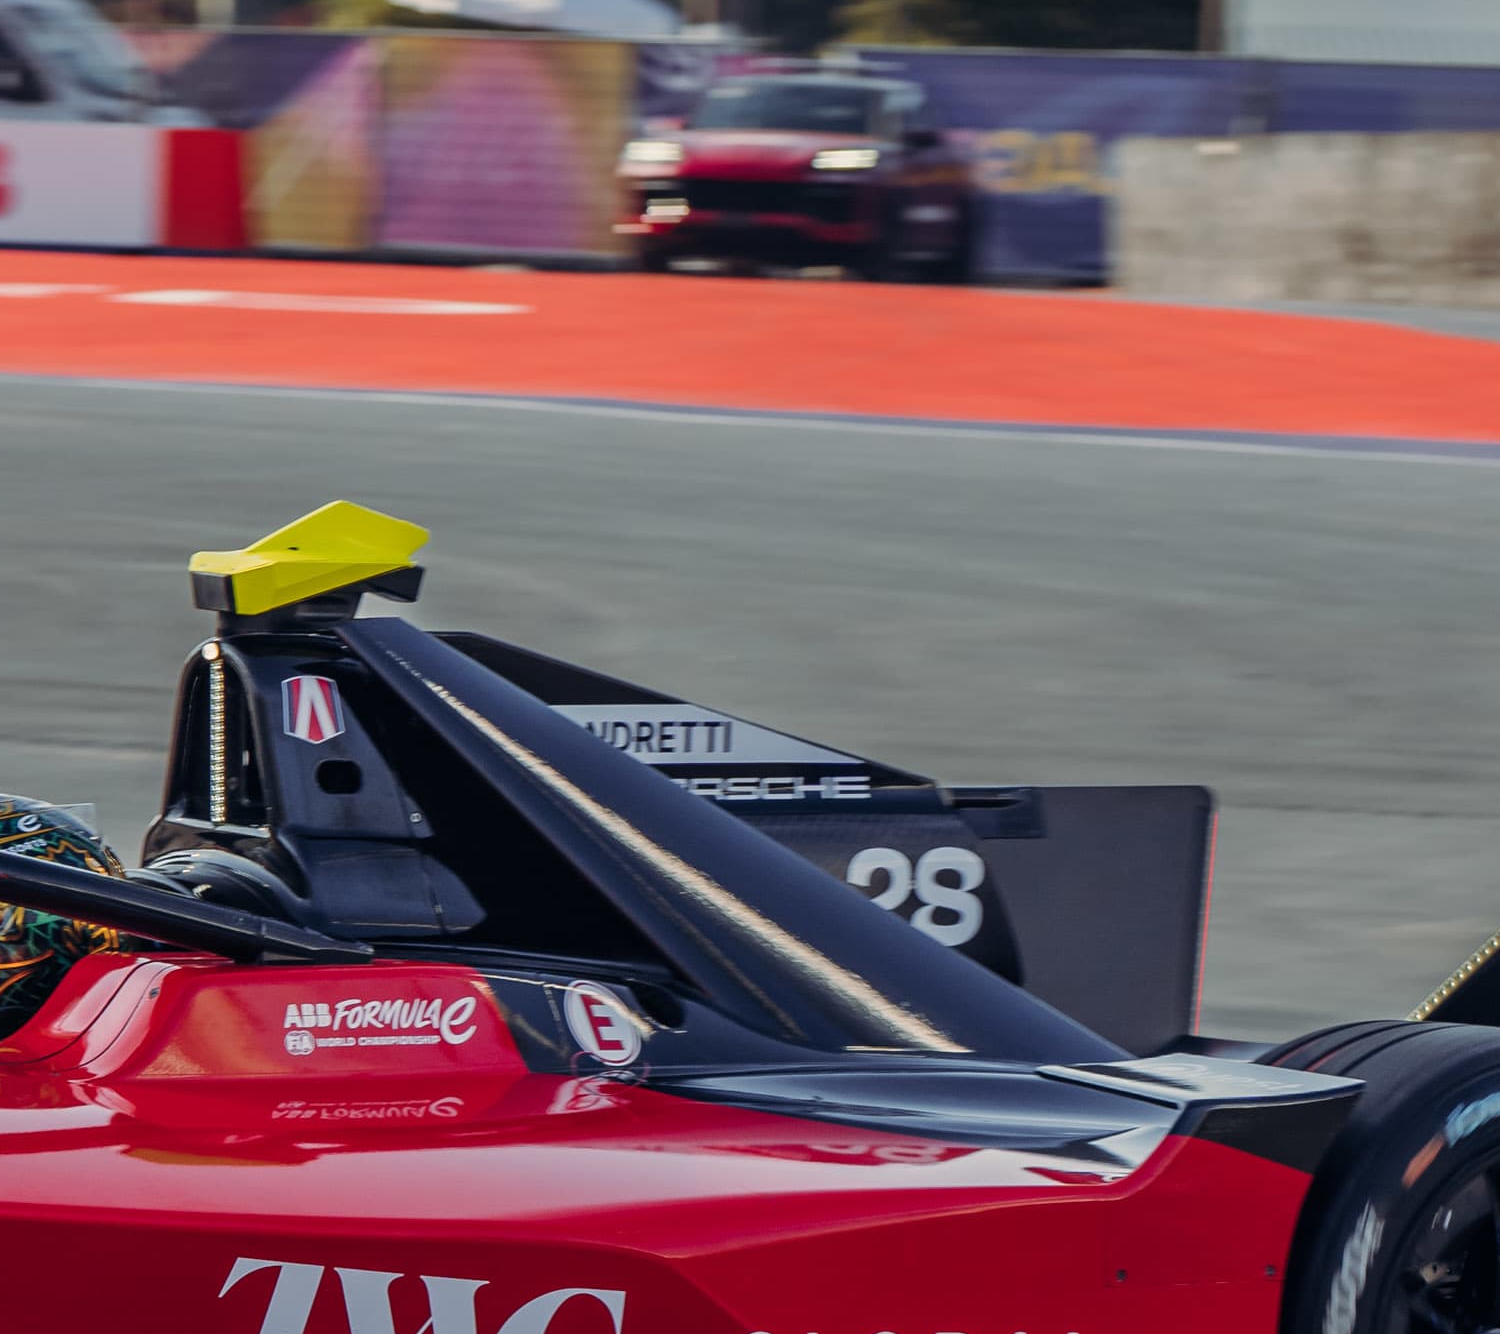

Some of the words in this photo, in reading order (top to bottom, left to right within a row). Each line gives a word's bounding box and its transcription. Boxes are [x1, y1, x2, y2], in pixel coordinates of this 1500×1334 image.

[585, 721, 733, 754] NDRETTI
[846, 846, 986, 947] 28
[284, 1002, 332, 1029] ABB
[332, 998, 442, 1031] FORMULA
